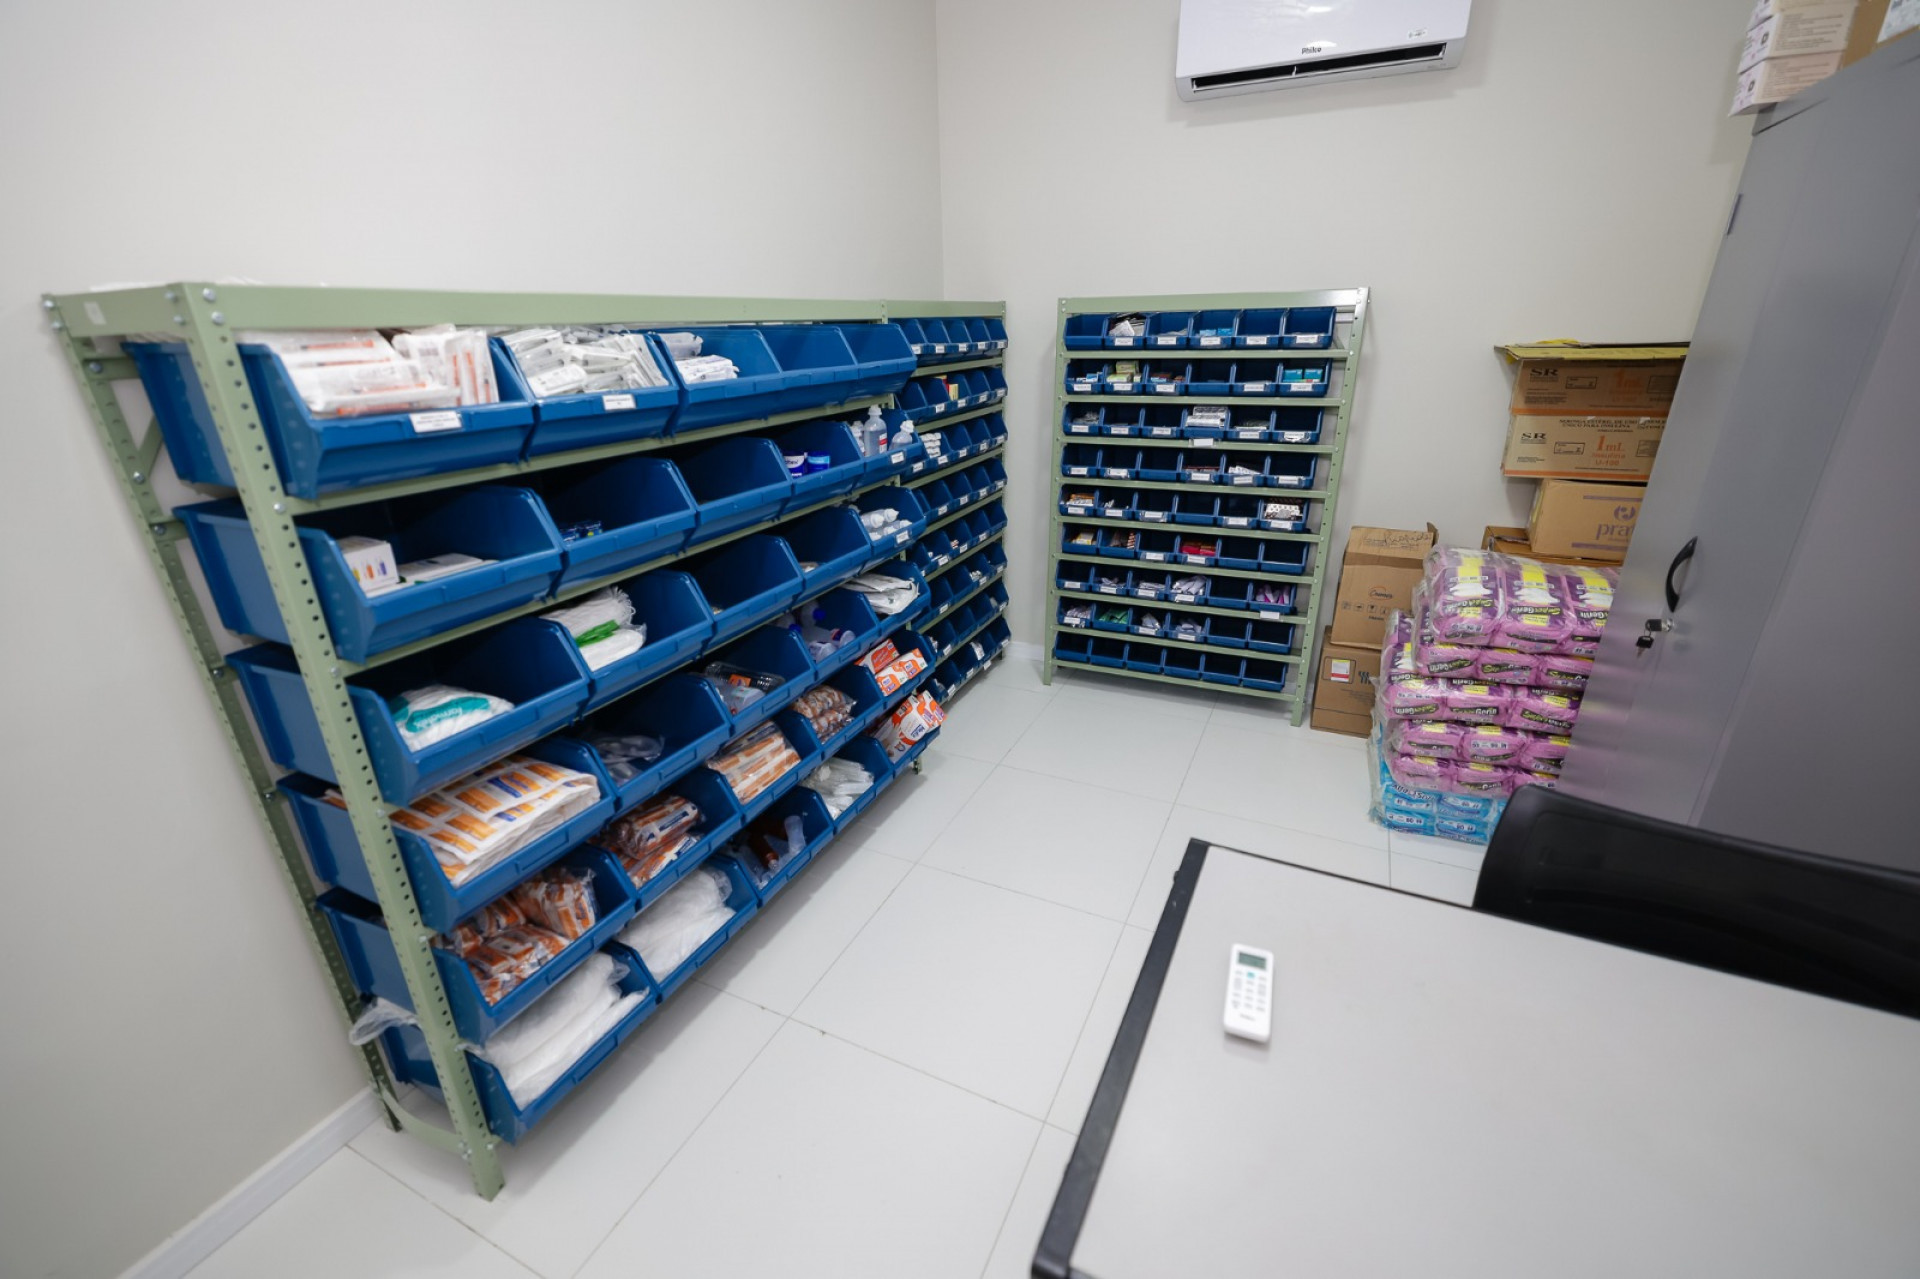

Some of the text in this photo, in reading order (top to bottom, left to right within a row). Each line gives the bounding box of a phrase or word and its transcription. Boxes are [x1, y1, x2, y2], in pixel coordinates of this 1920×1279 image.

[1301, 46, 1322, 55] Philco
[1531, 367, 1559, 376] SR
[1521, 432, 1547, 440] SR
